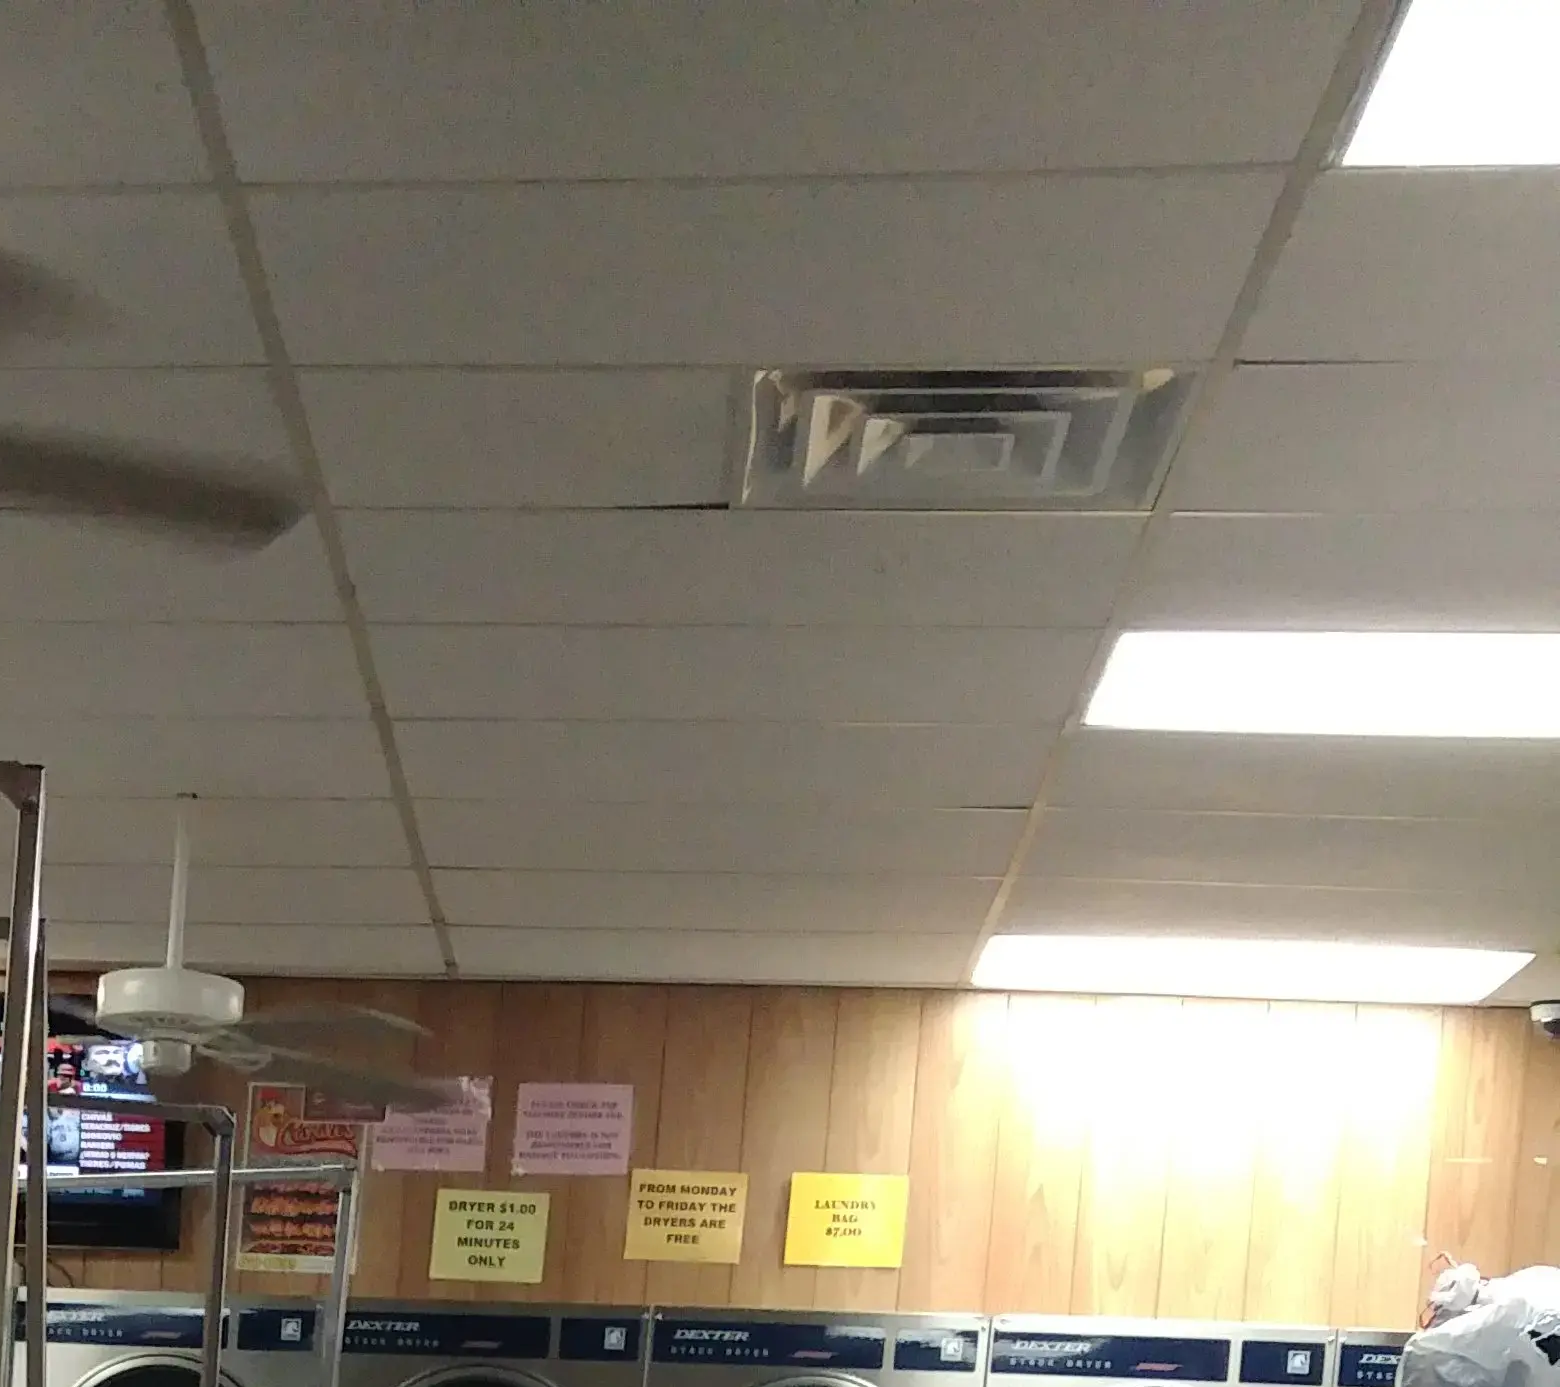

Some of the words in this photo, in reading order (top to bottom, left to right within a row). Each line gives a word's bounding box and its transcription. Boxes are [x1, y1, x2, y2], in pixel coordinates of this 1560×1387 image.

[639, 1184, 676, 1194] FROM
[680, 1185, 737, 1196] MONDAY
[449, 1201, 495, 1213] DRYER
[499, 1202, 536, 1215] $1.00
[637, 1200, 655, 1210] TO
[659, 1201, 706, 1212] FRIDAY
[711, 1203, 737, 1213] THE
[814, 1200, 876, 1210] LAUNDRY
[643, 1217, 696, 1228] DRYERS
[699, 1219, 726, 1229] ARE
[832, 1214, 858, 1223] BAG
[466, 1219, 493, 1230] FOR
[499, 1221, 515, 1231] 24
[825, 1227, 862, 1238] $7.00
[457, 1237, 520, 1249] MINUTES
[666, 1234, 699, 1244] FREE
[467, 1255, 506, 1267] ONLY
[346, 1320, 421, 1332] DEXTER
[674, 1328, 751, 1342] DEXTER
[1011, 1340, 1091, 1353] DEXTER
